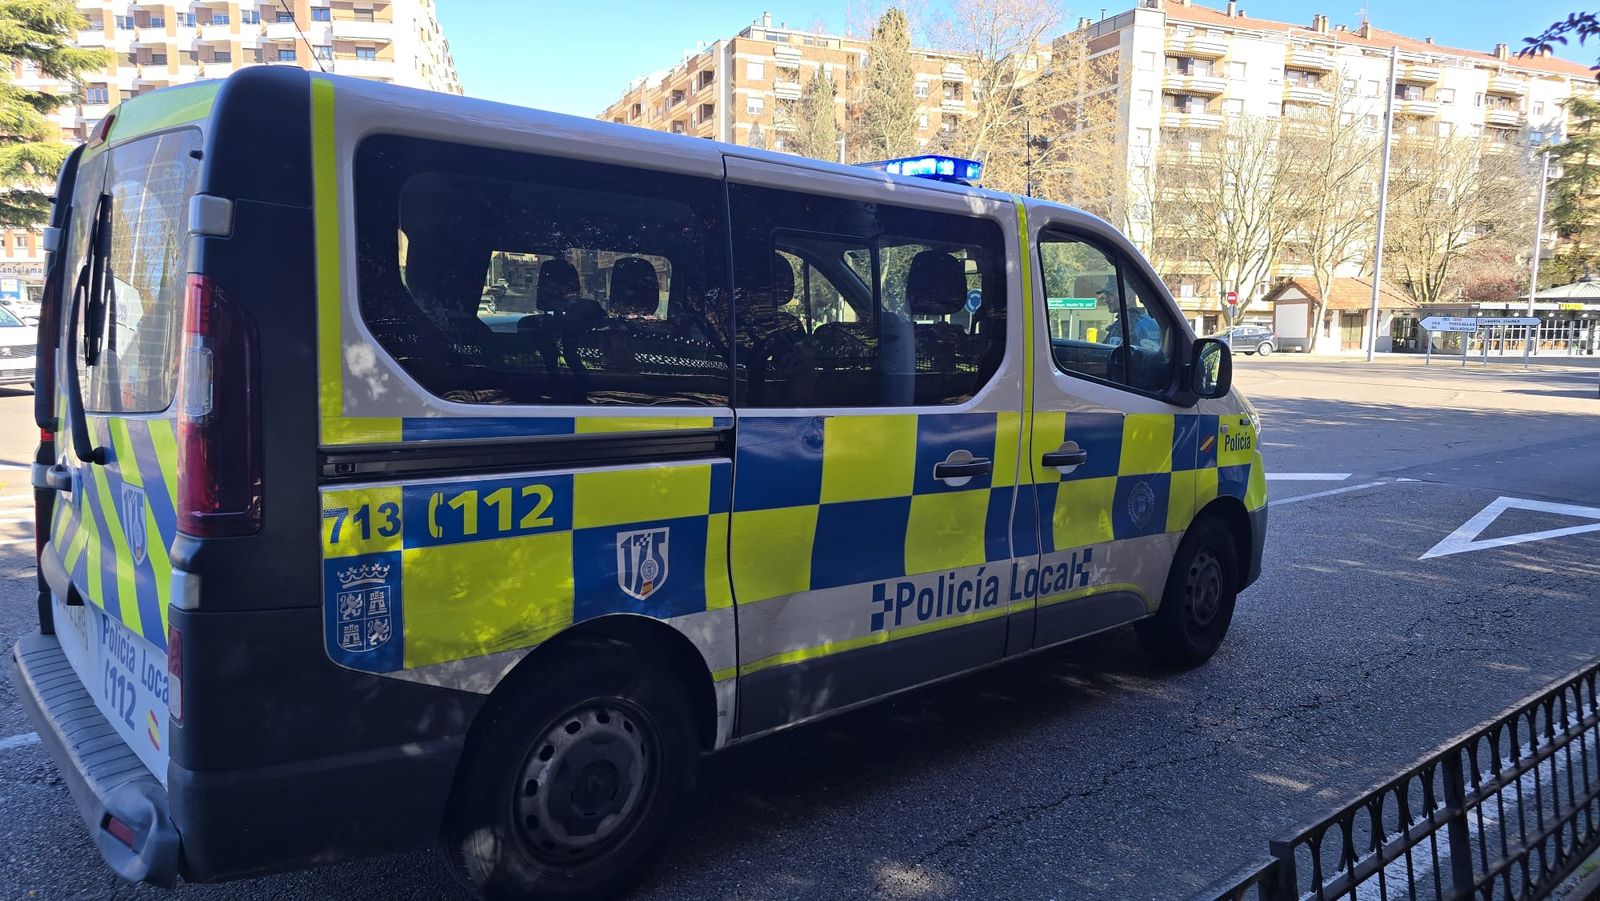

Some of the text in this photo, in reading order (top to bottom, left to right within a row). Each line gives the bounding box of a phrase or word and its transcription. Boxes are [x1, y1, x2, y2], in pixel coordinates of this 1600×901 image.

[1224, 432, 1251, 452] Policía
[323, 501, 401, 544] 713
[447, 484, 554, 535] 112
[894, 552, 1077, 626] Policía Local
[109, 665, 137, 732] 112
[141, 649, 168, 706] Loca
